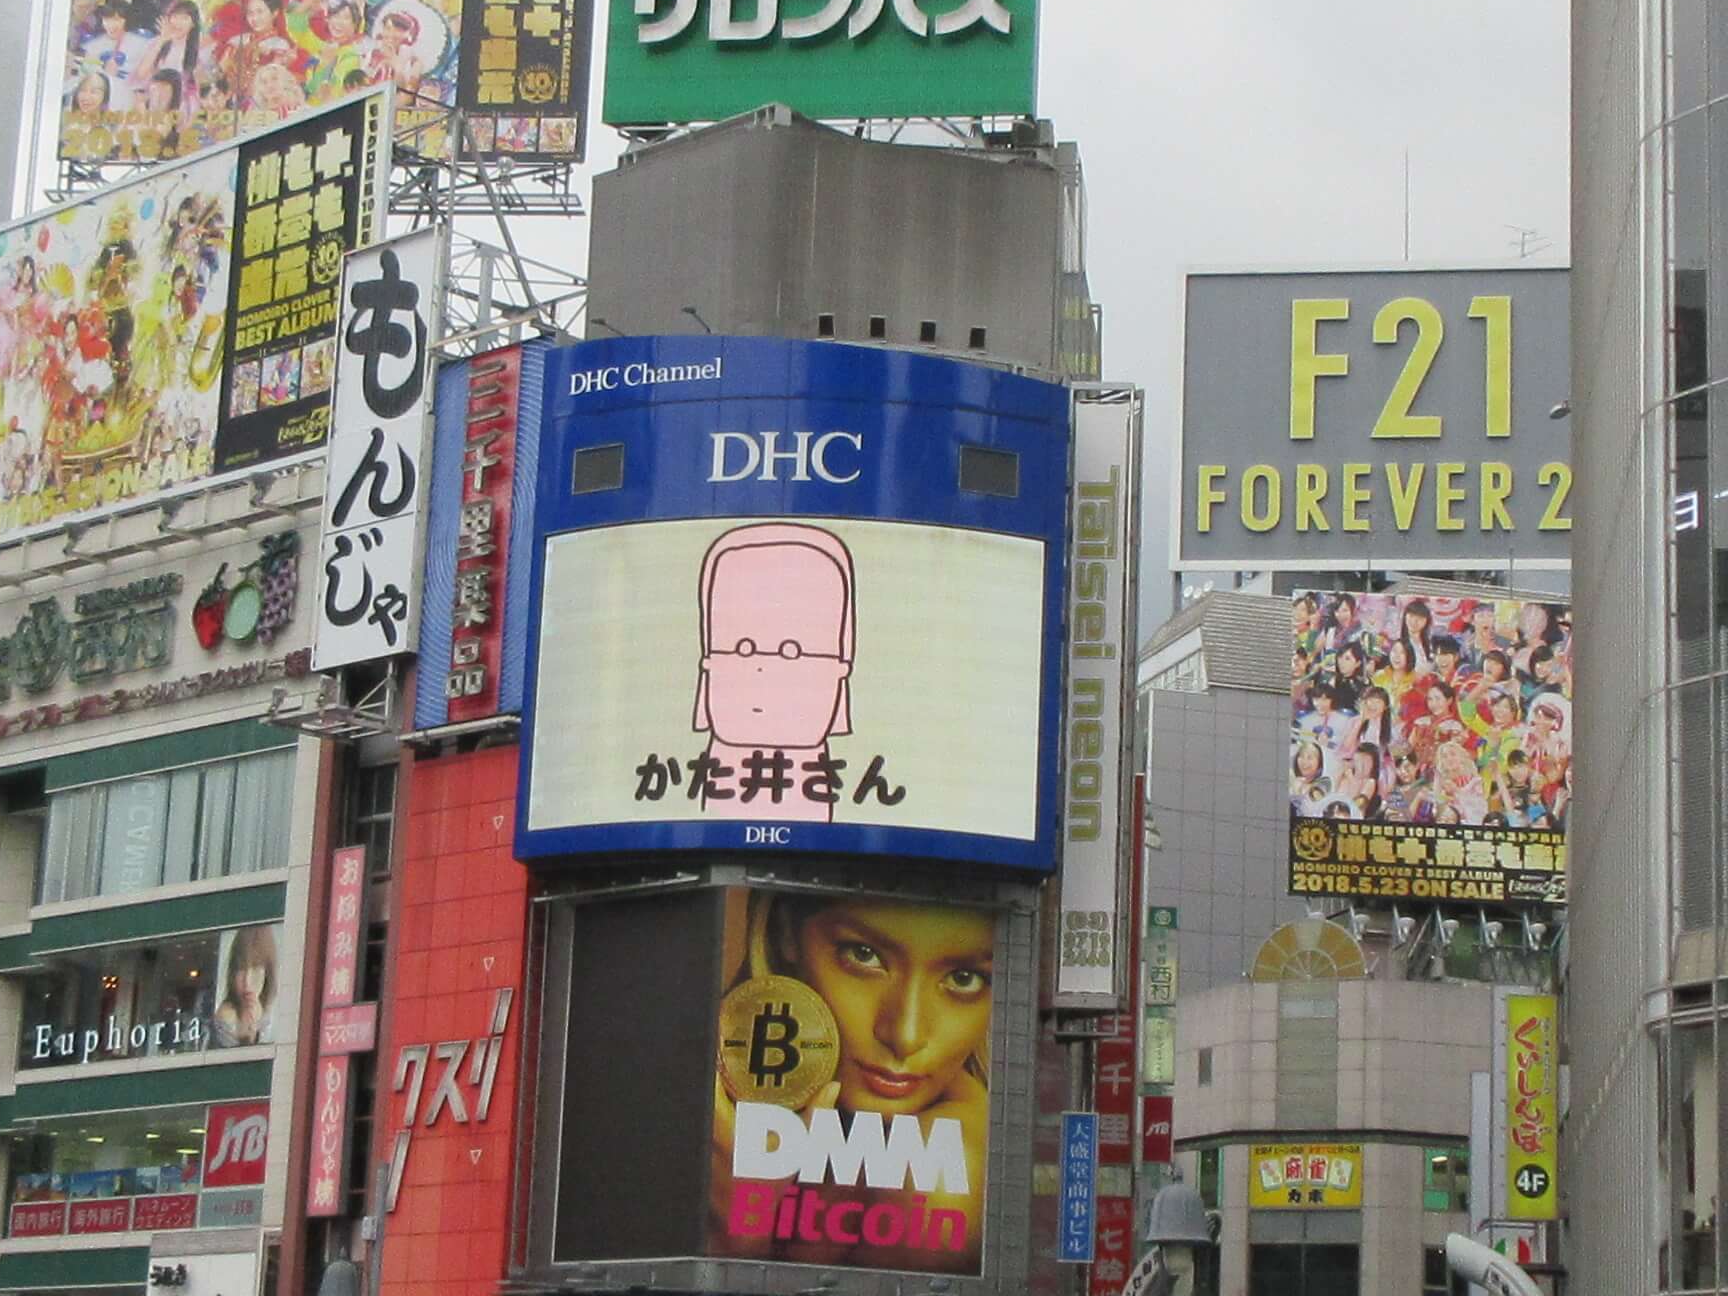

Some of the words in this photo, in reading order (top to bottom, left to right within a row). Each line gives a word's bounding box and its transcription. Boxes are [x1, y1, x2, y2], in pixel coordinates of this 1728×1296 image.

[235, 323, 278, 351] BEST
[277, 303, 338, 341] ALBUM
[569, 368, 620, 396] DHC
[623, 357, 723, 388] Channel
[1288, 294, 1512, 440] F21
[324, 247, 428, 648] もんじゃ
[705, 430, 864, 485] DHC
[1196, 462, 1514, 533] FOREVER
[443, 358, 507, 702] 三千里薬品
[1071, 463, 1121, 661] Taisei
[633, 749, 908, 806] かた井さん
[1068, 675, 1108, 843] neon
[744, 824, 791, 845] DHC
[1292, 861, 1361, 876] MOMOIRO
[1362, 863, 1413, 878] CLOVER
[1414, 867, 1424, 878] Z
[1426, 867, 1457, 880] BEST
[1458, 869, 1505, 882] ALBUM
[1292, 874, 1410, 897] 2018.5.23
[1411, 879, 1447, 898] ON
[1449, 881, 1505, 901] SALE
[33, 1012, 203, 1064] Euphoria
[208, 1113, 267, 1174] JTB
[733, 1100, 970, 1194] DMM
[1515, 1169, 1546, 1192] 4F
[73, 1204, 130, 1229] 海外旅行
[727, 1181, 967, 1252] Bitcoin
